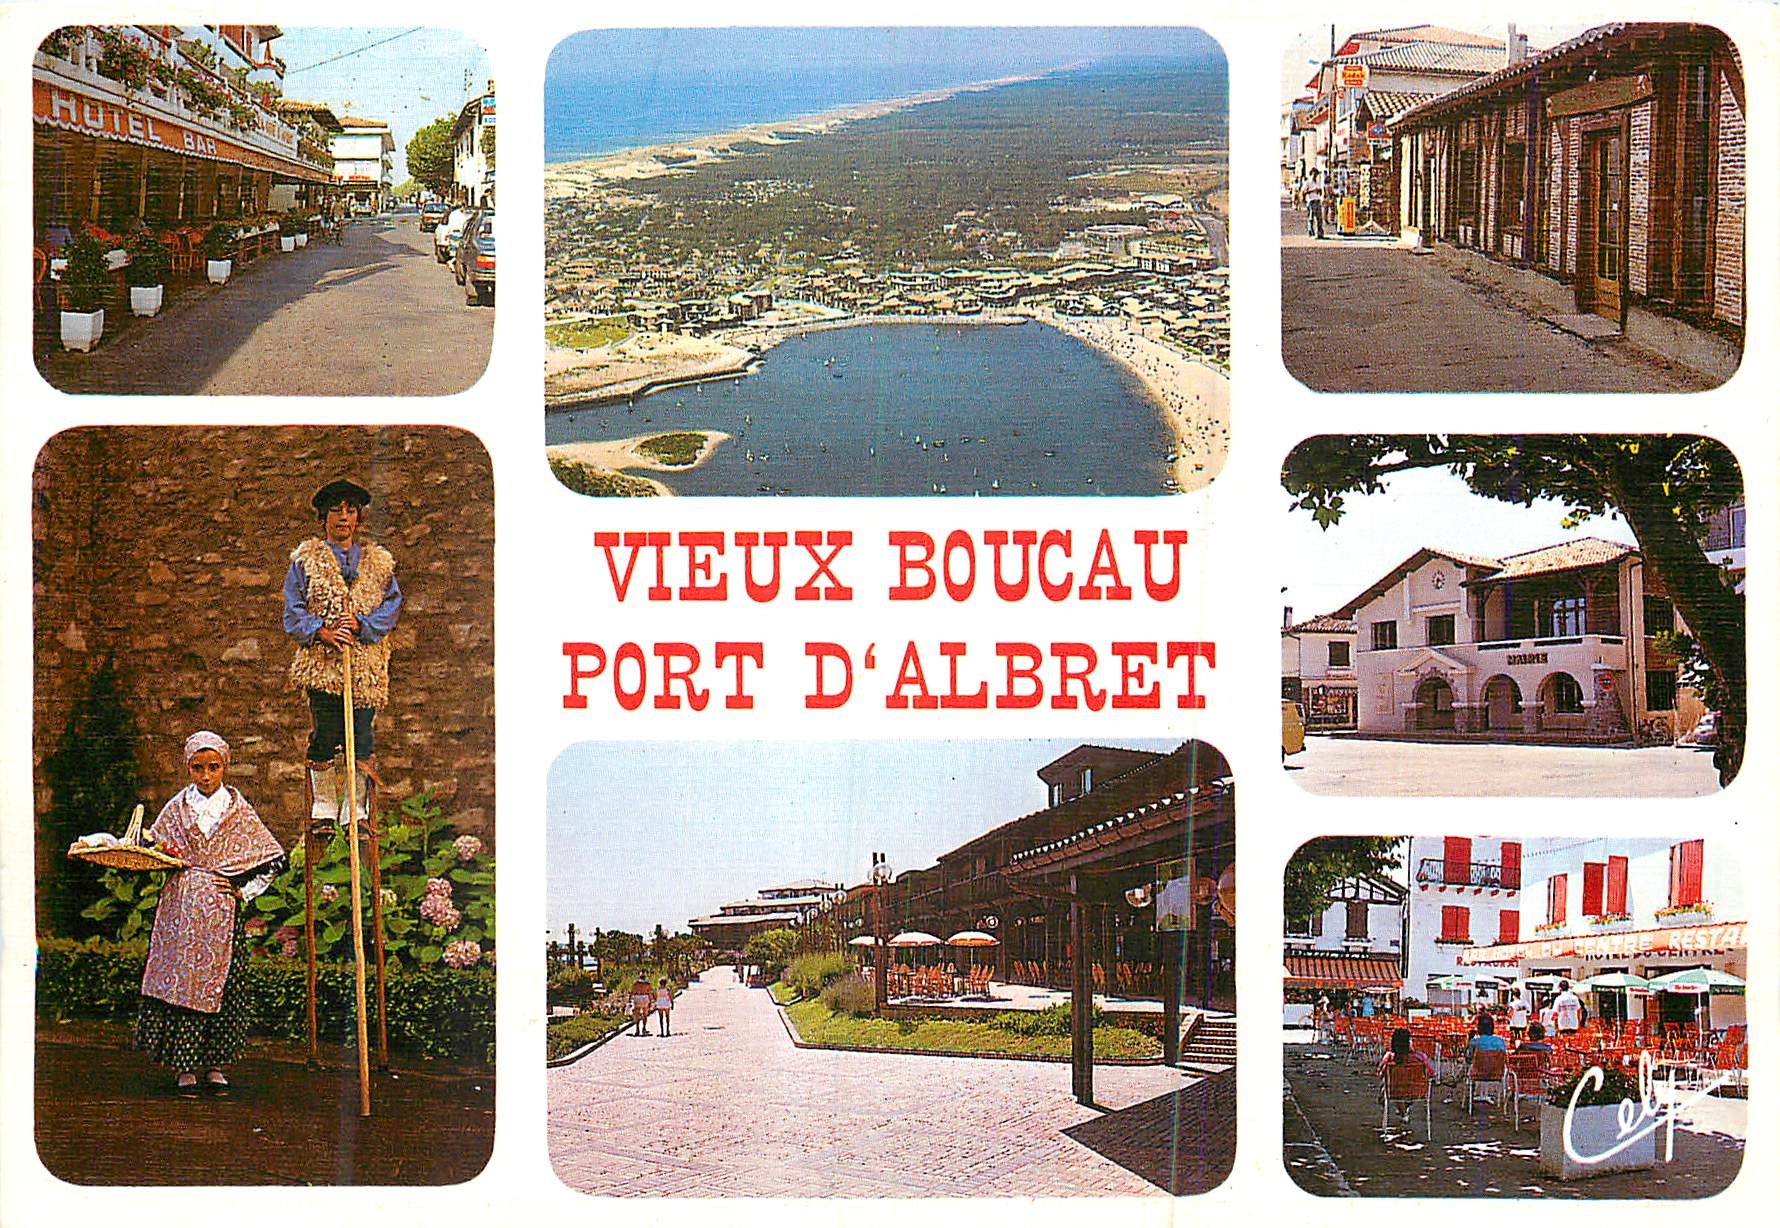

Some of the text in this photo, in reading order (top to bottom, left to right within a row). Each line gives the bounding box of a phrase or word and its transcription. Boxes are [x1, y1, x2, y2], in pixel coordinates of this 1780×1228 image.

[51, 89, 217, 155] HOTEL BAR
[1573, 933, 1655, 958] CENTRE
